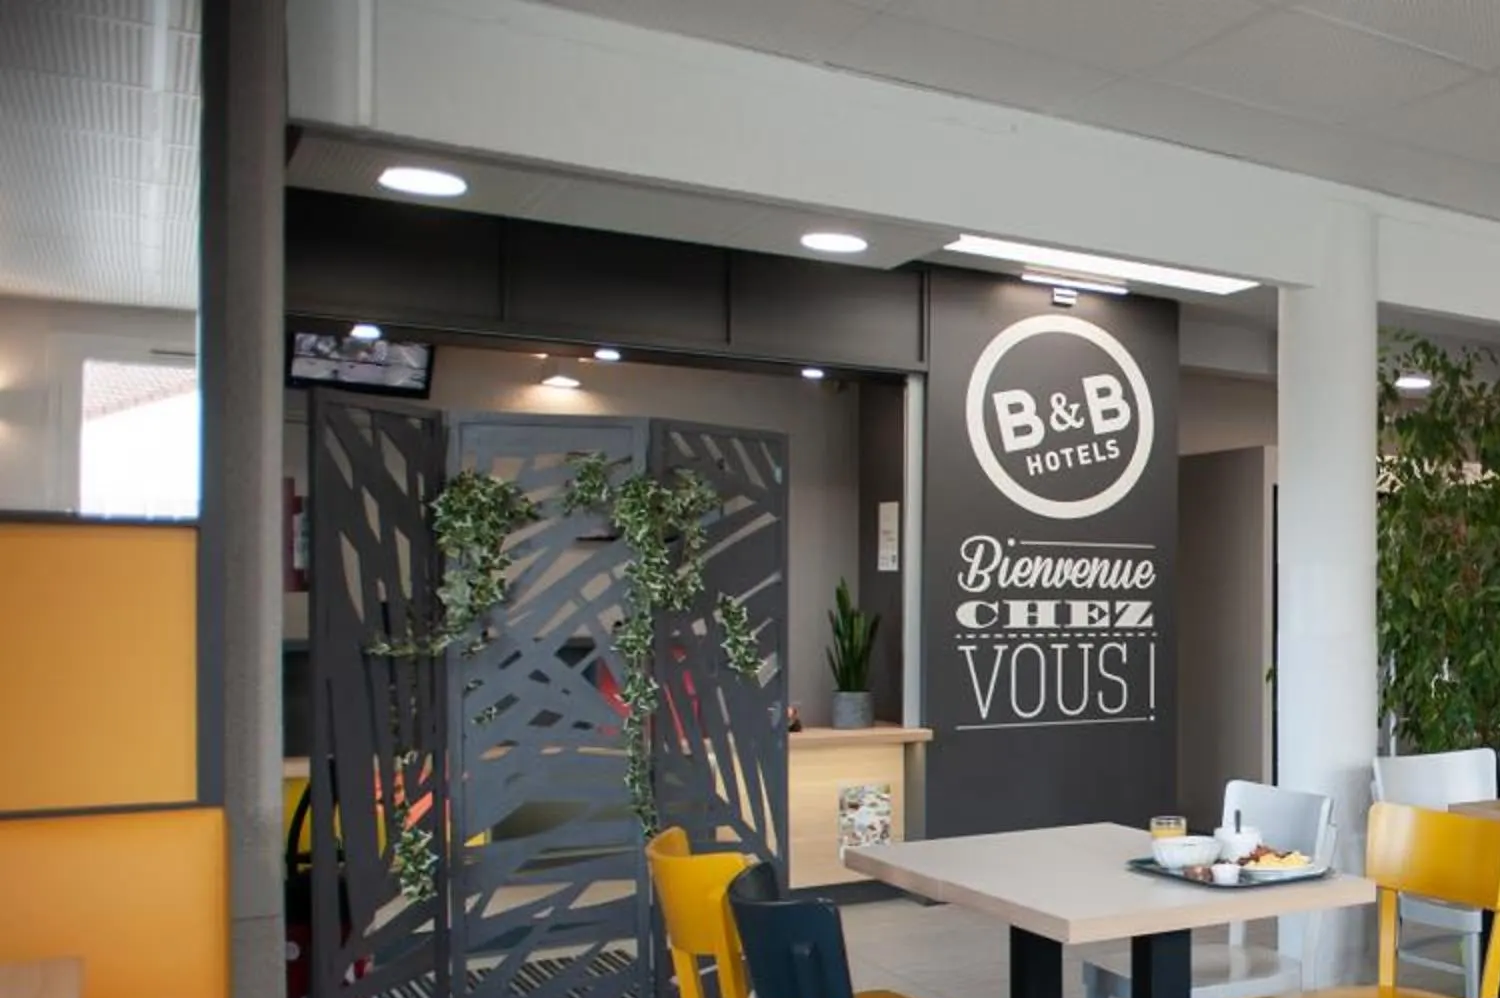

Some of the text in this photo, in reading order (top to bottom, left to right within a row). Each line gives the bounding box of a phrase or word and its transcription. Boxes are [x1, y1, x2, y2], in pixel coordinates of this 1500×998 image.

[992, 373, 1132, 454] B&B
[1025, 438, 1121, 477] HOTELS
[957, 534, 1157, 593] Bienvenue
[955, 600, 1154, 629] CHEZ
